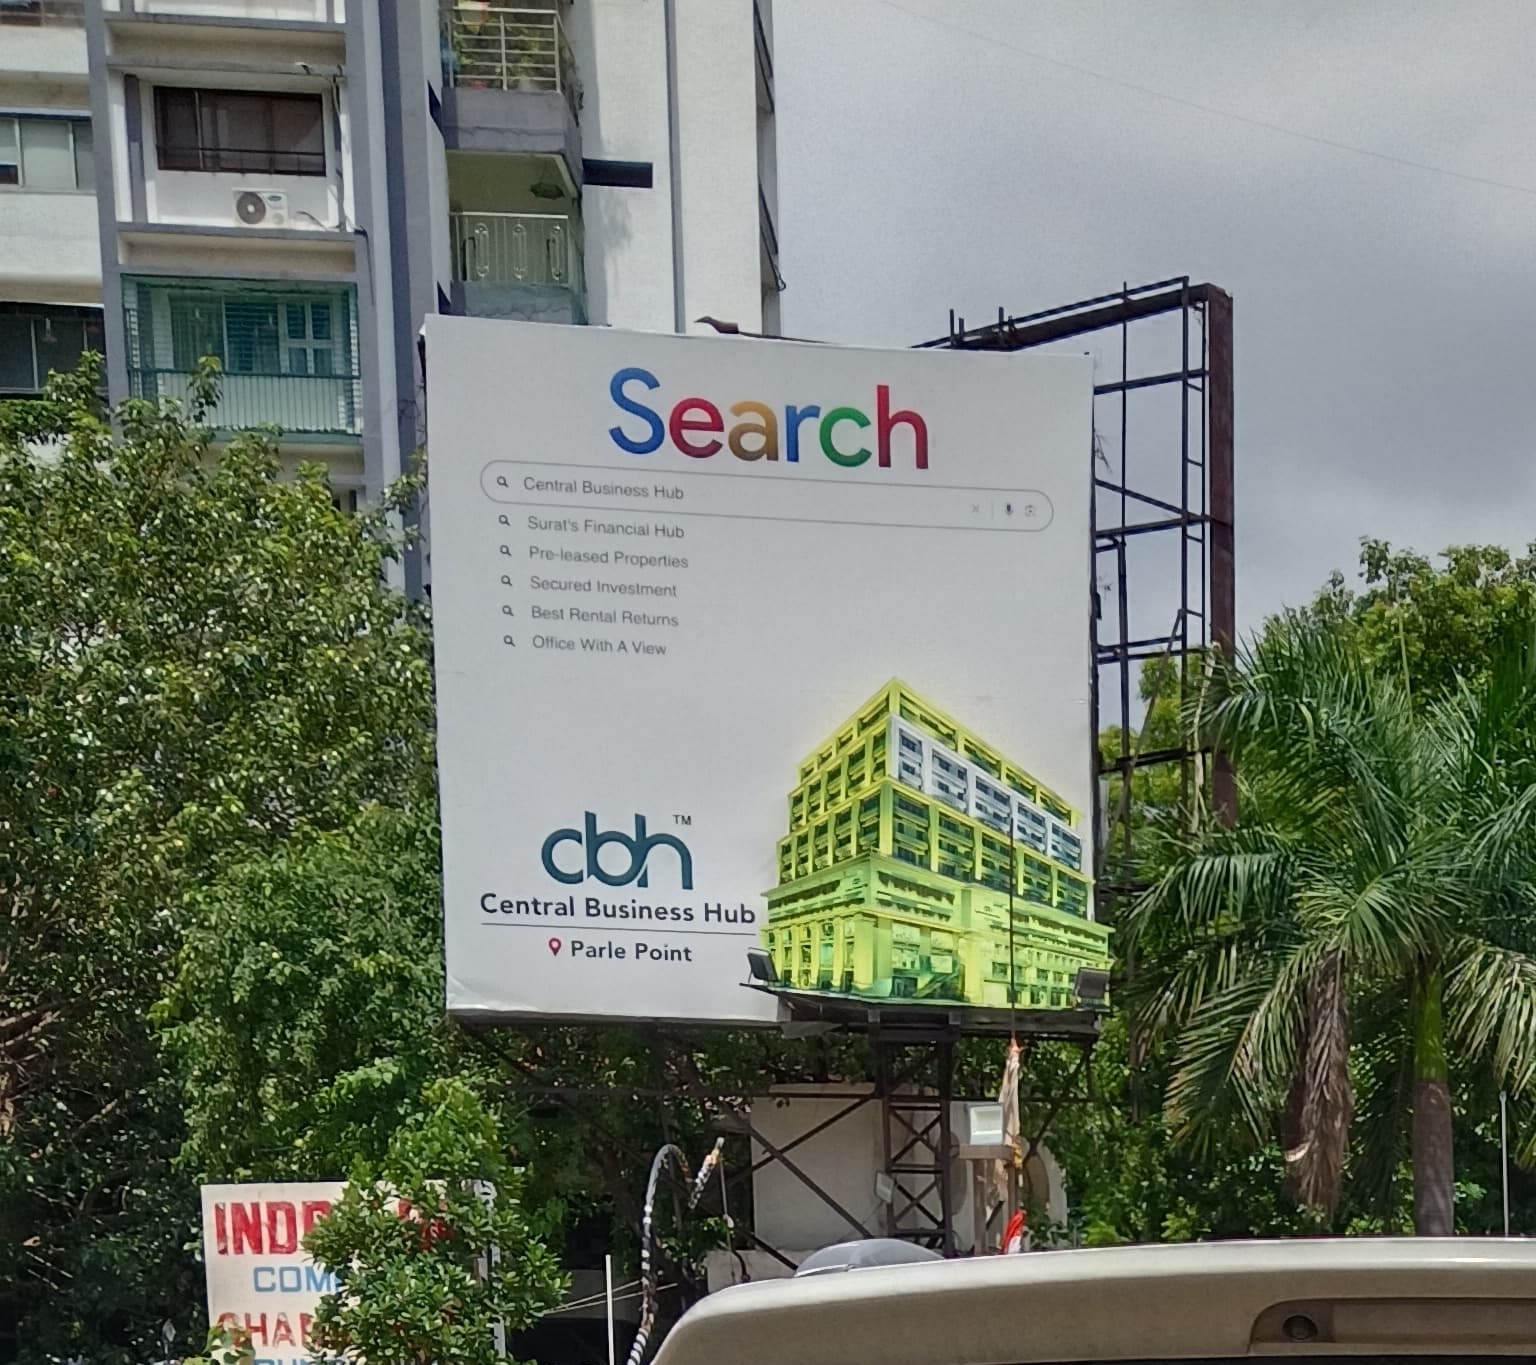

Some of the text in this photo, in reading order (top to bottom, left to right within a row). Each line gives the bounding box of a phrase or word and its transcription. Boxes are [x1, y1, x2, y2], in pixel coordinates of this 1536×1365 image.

[608, 367, 929, 470] Search
[523, 476, 684, 500] Central Business Hub
[527, 516, 685, 538] Surat's Financial Hub
[529, 545, 689, 569] Pre-leased Properties
[530, 575, 678, 598] Secured Investment
[531, 605, 680, 627] Best Rental Returns
[532, 635, 667, 655] Office With A View
[541, 810, 694, 890] cbh
[480, 893, 756, 924] Central Business Hub
[571, 940, 692, 962] Parle Point
